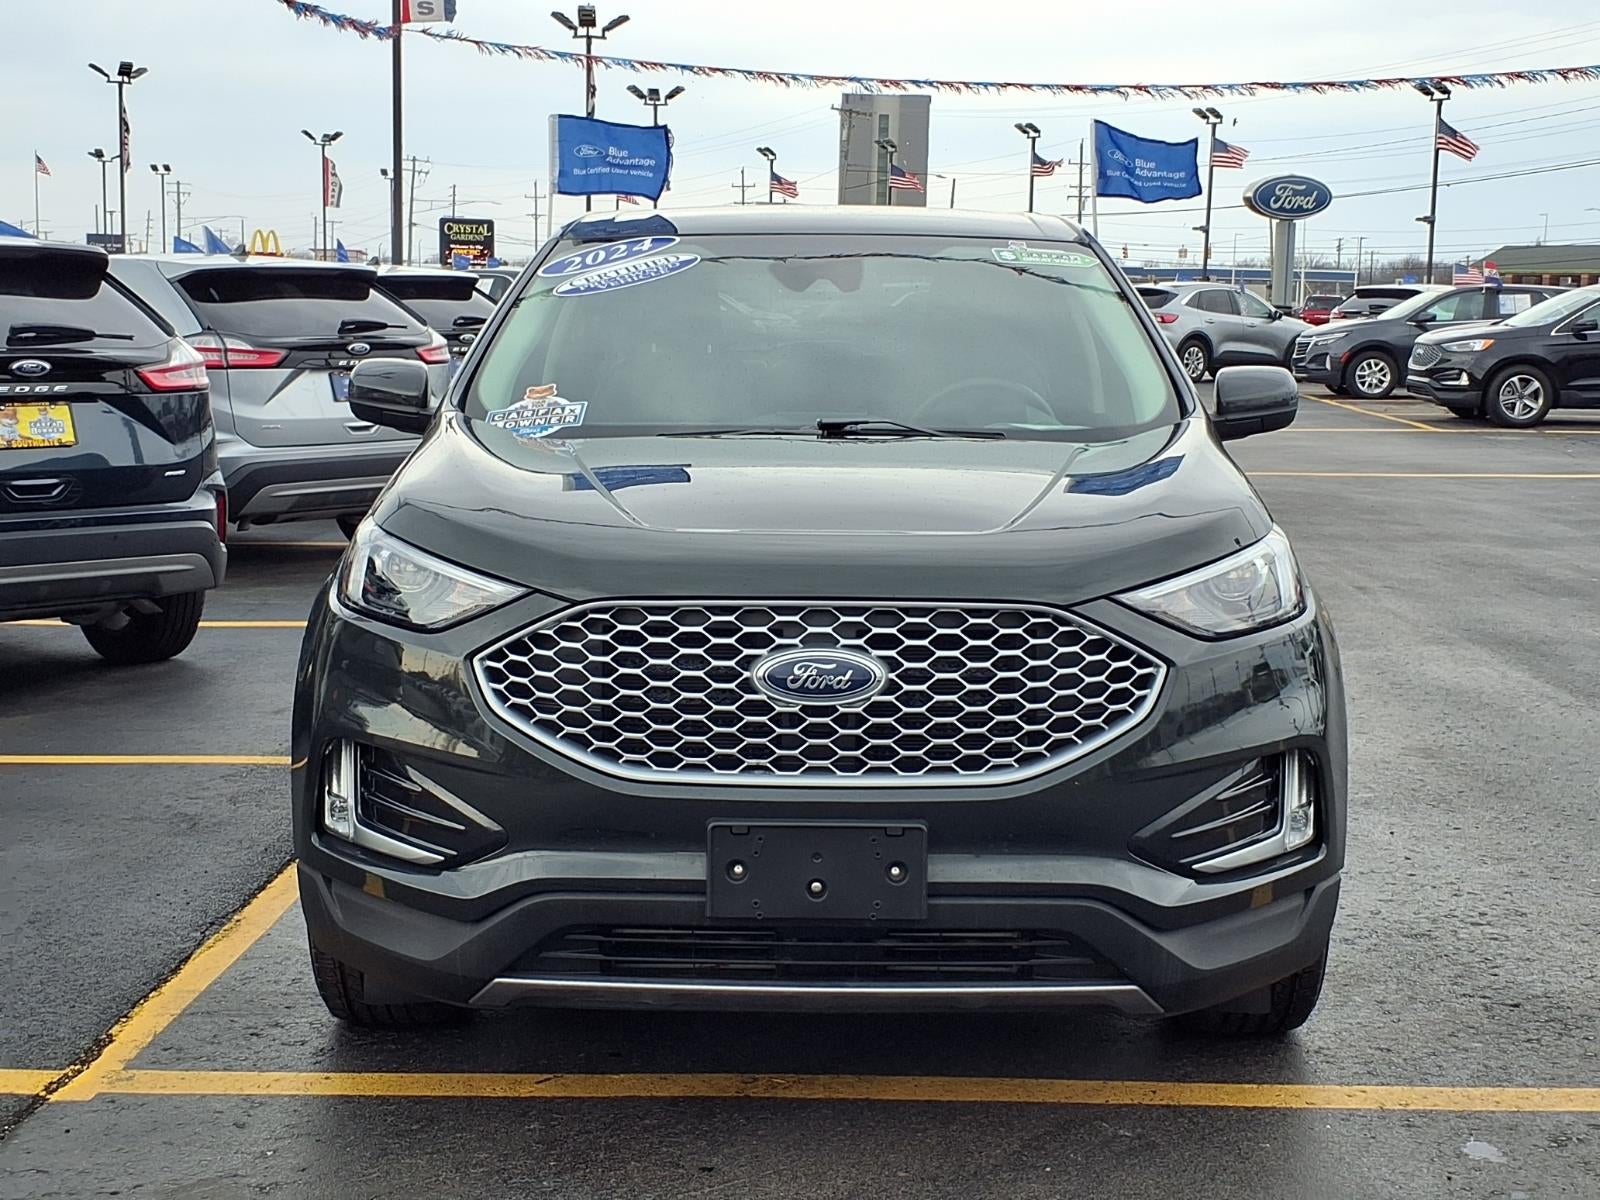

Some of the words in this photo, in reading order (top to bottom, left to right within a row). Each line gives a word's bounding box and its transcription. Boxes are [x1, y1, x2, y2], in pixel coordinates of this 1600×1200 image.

[608, 146, 629, 157] Blue
[606, 156, 656, 167] Advantage
[1135, 158, 1156, 169] Blue
[587, 166, 610, 175] Certified
[630, 169, 654, 178] Vehicle
[1135, 168, 1186, 180] Advantage
[1269, 183, 1318, 209] Ford
[450, 233, 485, 241] GARDENS
[563, 238, 653, 273] 2024
[569, 256, 680, 288] CERTIFIED
[0, 385, 69, 393] EDGE
[493, 406, 578, 421] CARFAX
[505, 415, 576, 429] OWNER
[11, 439, 59, 448] SOUTHGATE
[786, 661, 854, 690] Ford
